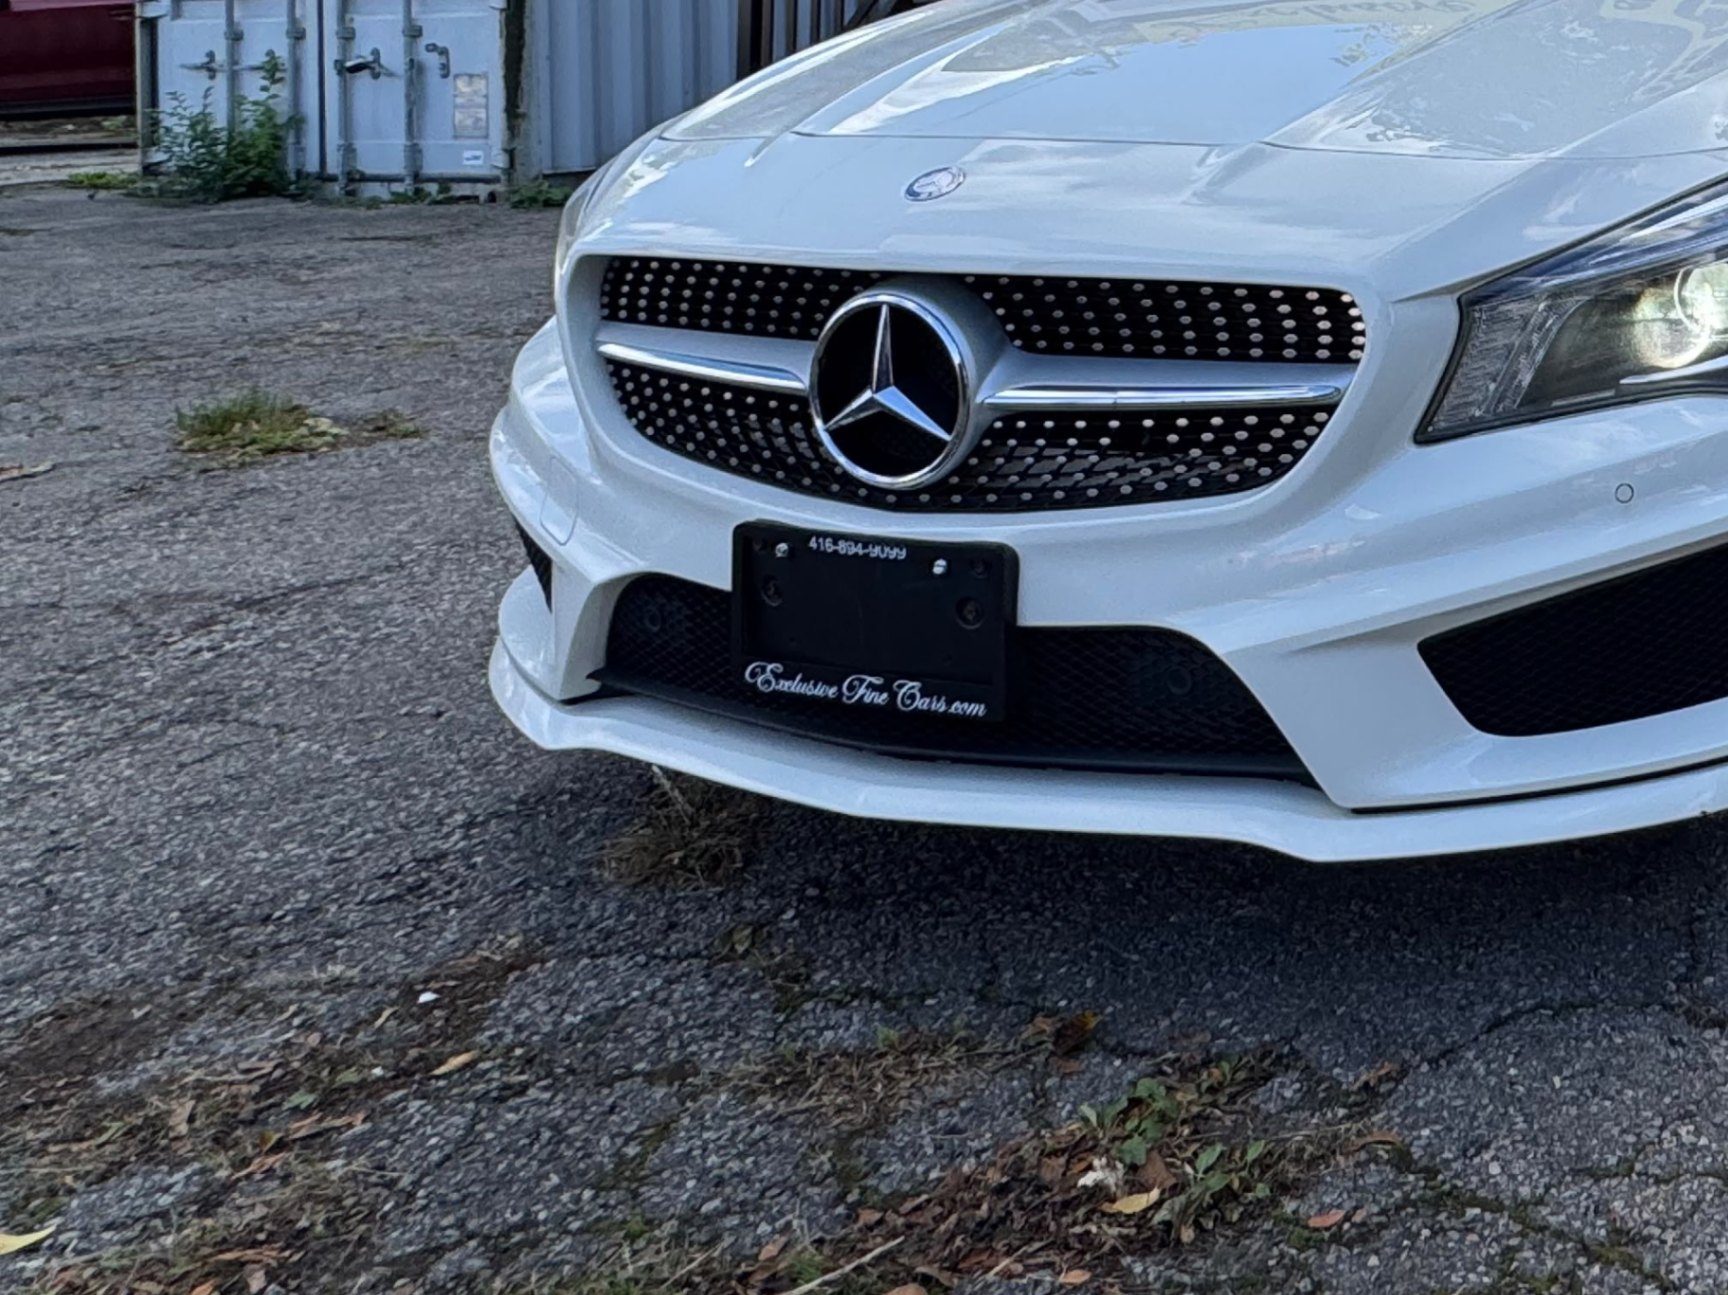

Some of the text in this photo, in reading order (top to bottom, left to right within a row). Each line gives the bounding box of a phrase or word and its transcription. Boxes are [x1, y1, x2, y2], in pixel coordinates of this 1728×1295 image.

[744, 661, 987, 718] Exclusive Fine Cars.com
